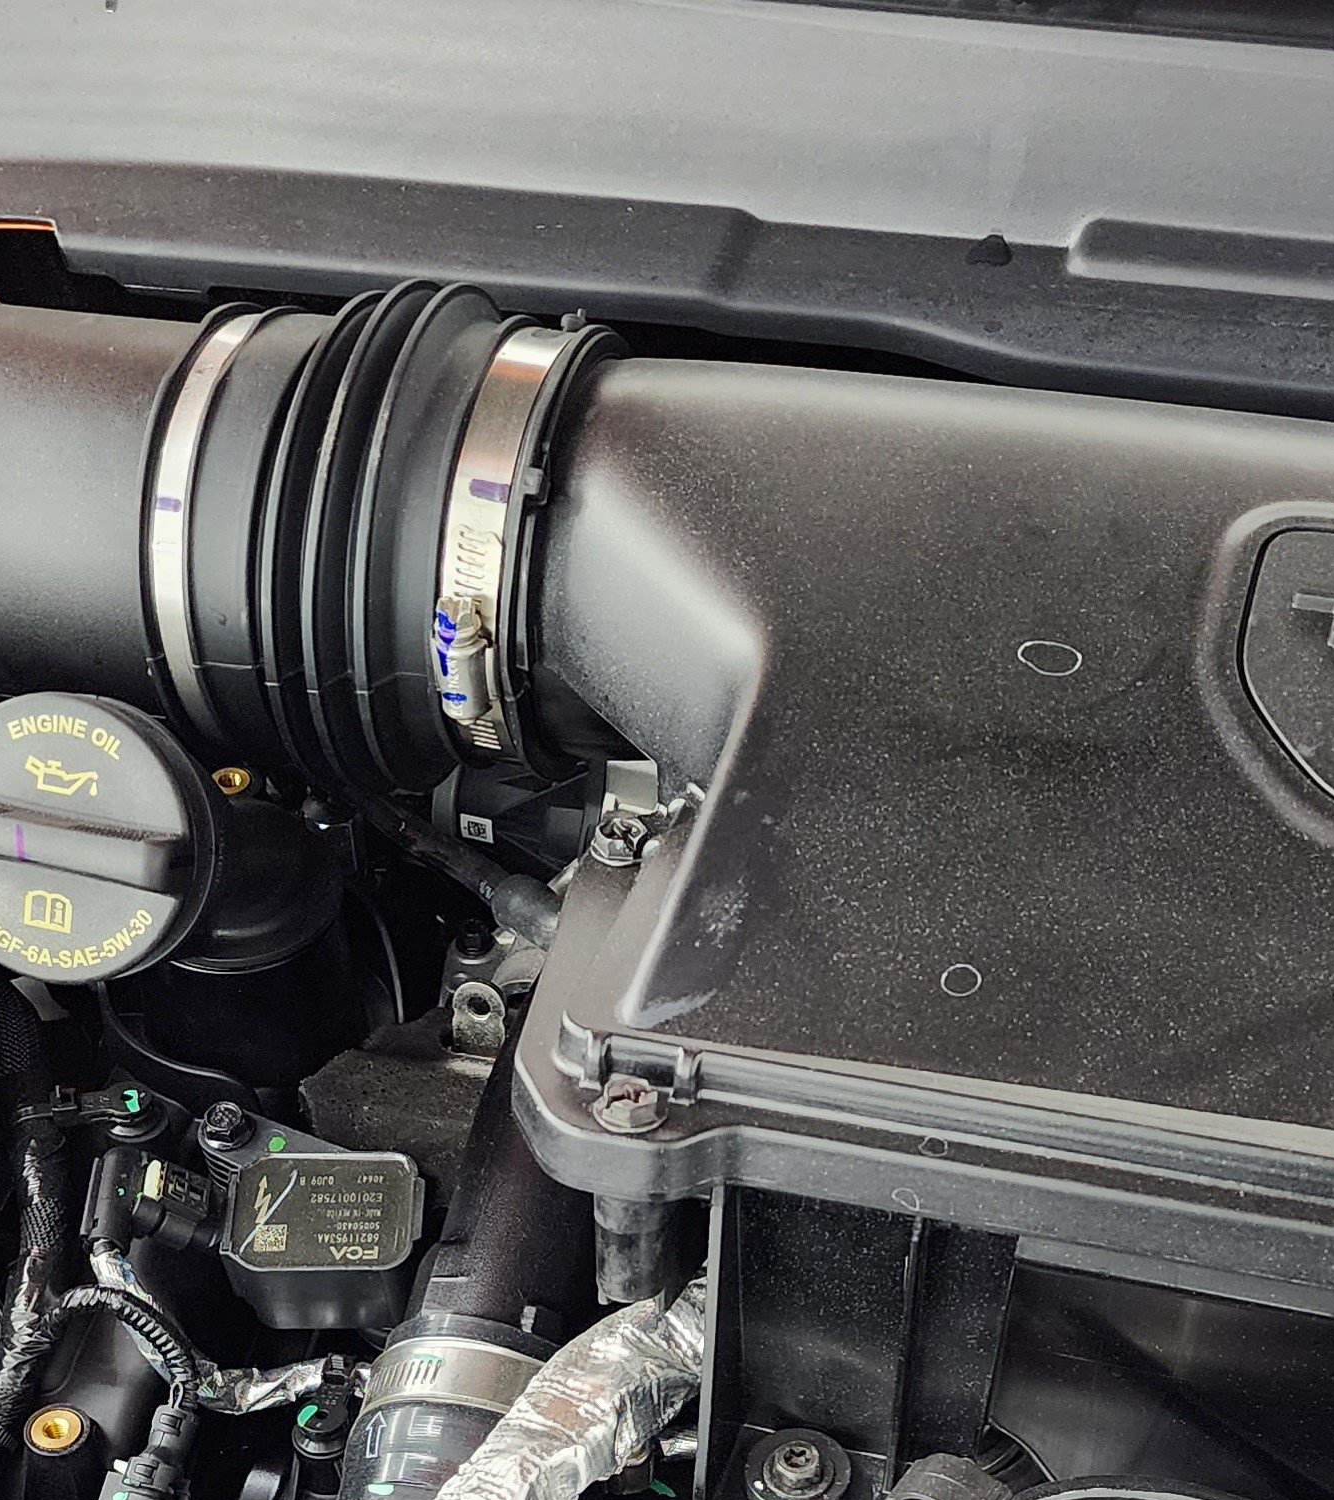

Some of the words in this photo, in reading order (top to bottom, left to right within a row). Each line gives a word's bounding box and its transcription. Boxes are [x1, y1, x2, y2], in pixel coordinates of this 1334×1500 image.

[7, 714, 88, 740] ENGINE
[91, 727, 123, 760] OIL
[329, 1246, 379, 1260] FCA
